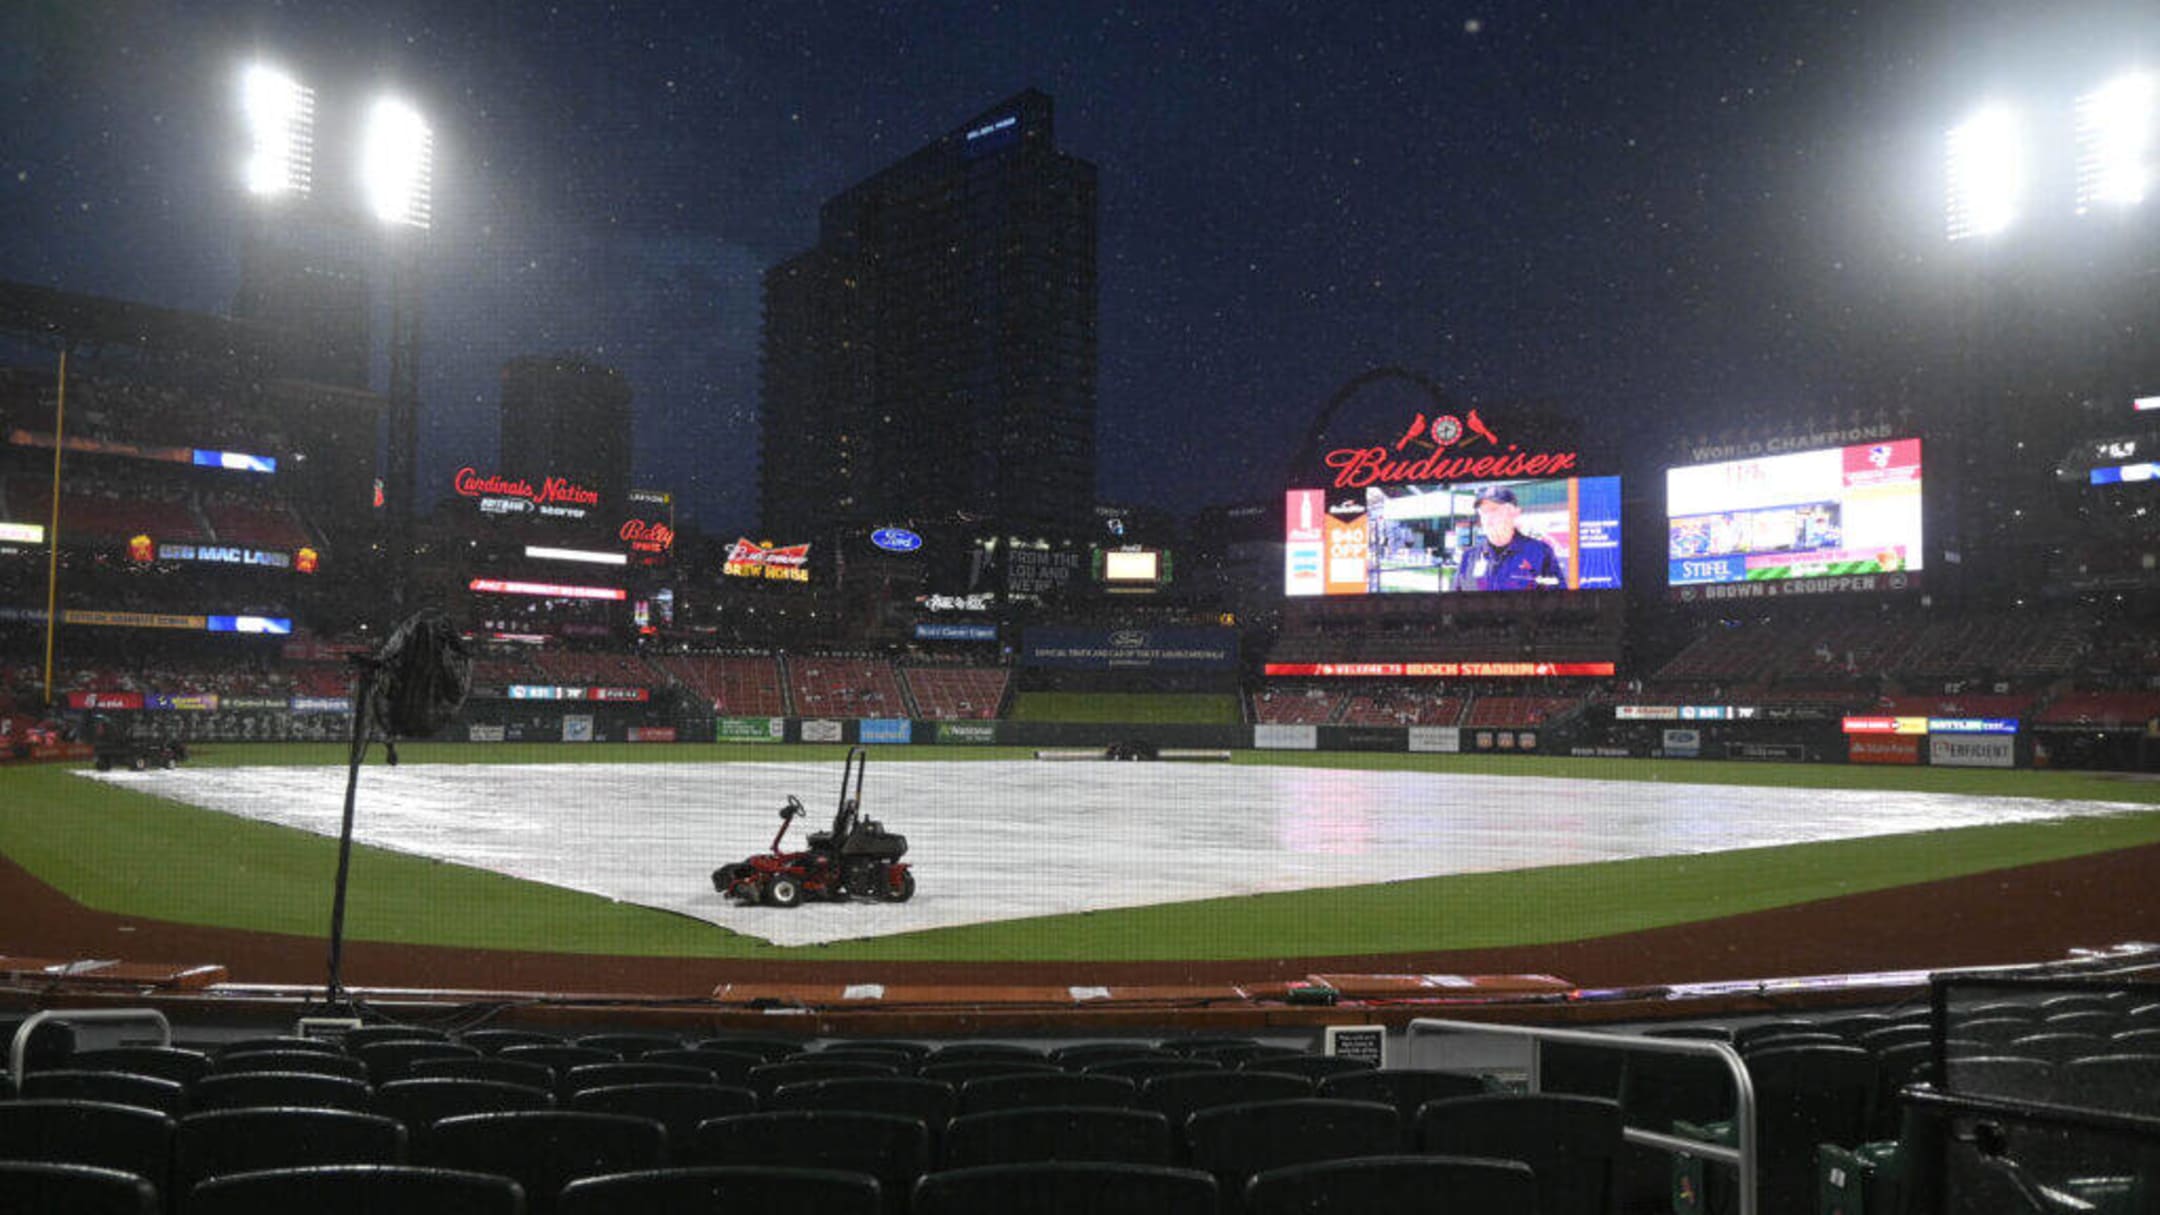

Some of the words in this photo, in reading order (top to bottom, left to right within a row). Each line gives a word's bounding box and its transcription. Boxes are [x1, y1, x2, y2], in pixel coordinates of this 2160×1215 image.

[1692, 443, 1761, 461] WORLD
[1767, 424, 1893, 453] CHAMPIONS
[1325, 445, 1577, 488] Budweiser
[455, 467, 534, 497] Cardinals
[533, 476, 599, 504] Nation
[619, 519, 675, 550] Bally
[882, 531, 913, 547] Ford
[197, 545, 240, 562] MAC
[243, 549, 291, 567] LAND
[1053, 553, 1080, 567] THE
[1682, 560, 1731, 578] STIFEL
[1706, 583, 1764, 599] BROWN
[1783, 576, 1875, 594] CROUPPEN
[1406, 664, 1458, 676] BUSCH
[1461, 663, 1535, 676] STADIUM
